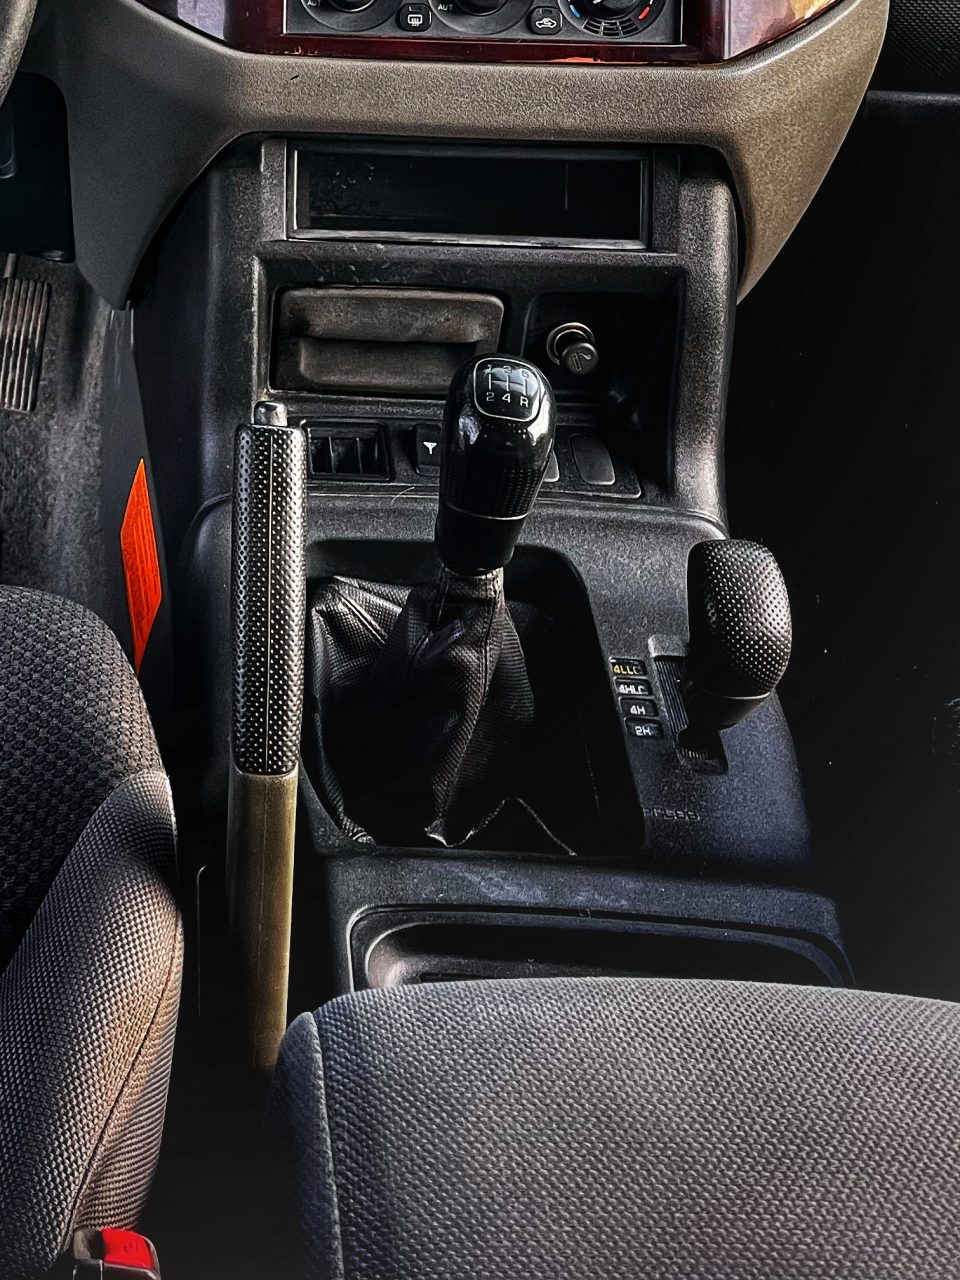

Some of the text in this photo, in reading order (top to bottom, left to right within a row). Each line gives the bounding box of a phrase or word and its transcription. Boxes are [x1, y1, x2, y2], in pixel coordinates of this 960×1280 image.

[502, 365, 513, 374] 3
[486, 391, 529, 408] 2 4 R
[630, 705, 646, 715] 4H
[635, 725, 652, 736] 2H
